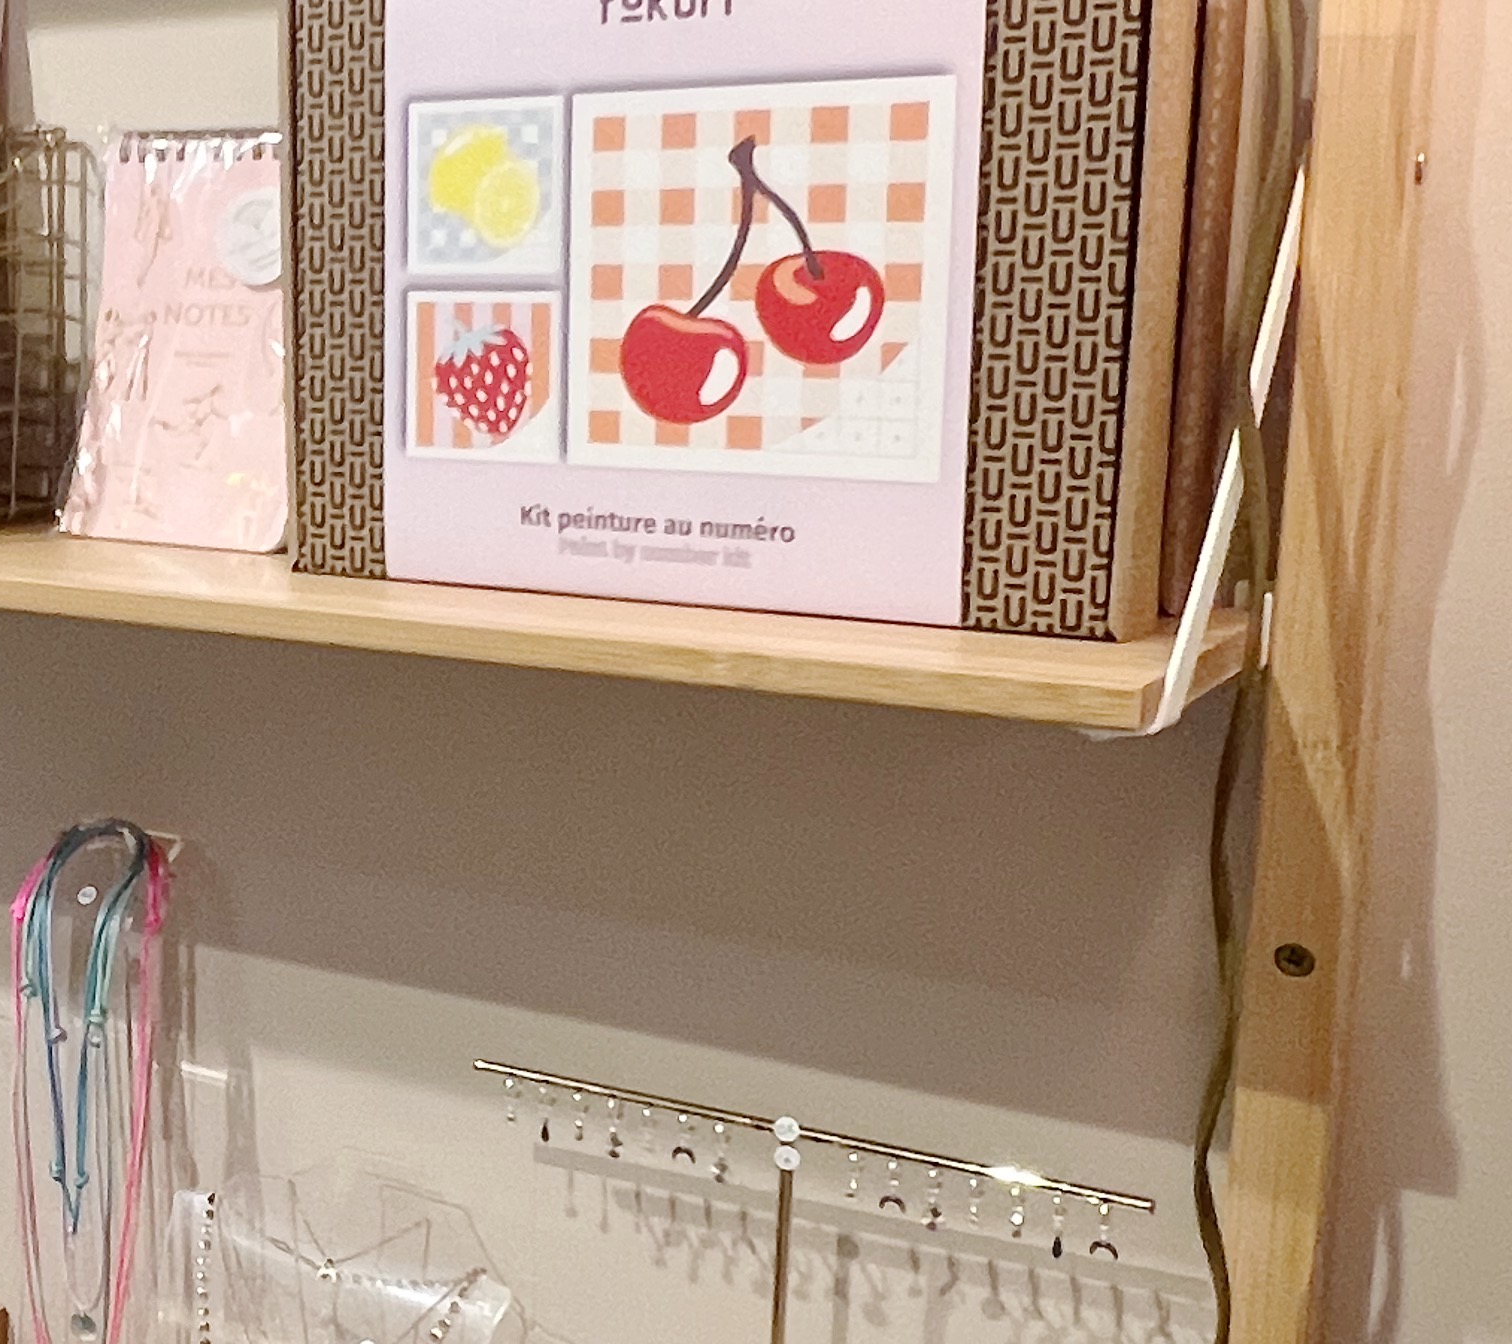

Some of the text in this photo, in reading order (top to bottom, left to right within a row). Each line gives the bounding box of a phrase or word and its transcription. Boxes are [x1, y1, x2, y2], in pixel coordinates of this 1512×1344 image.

[162, 302, 253, 327] NOTES
[520, 503, 796, 543] Kit peinture au numéro
